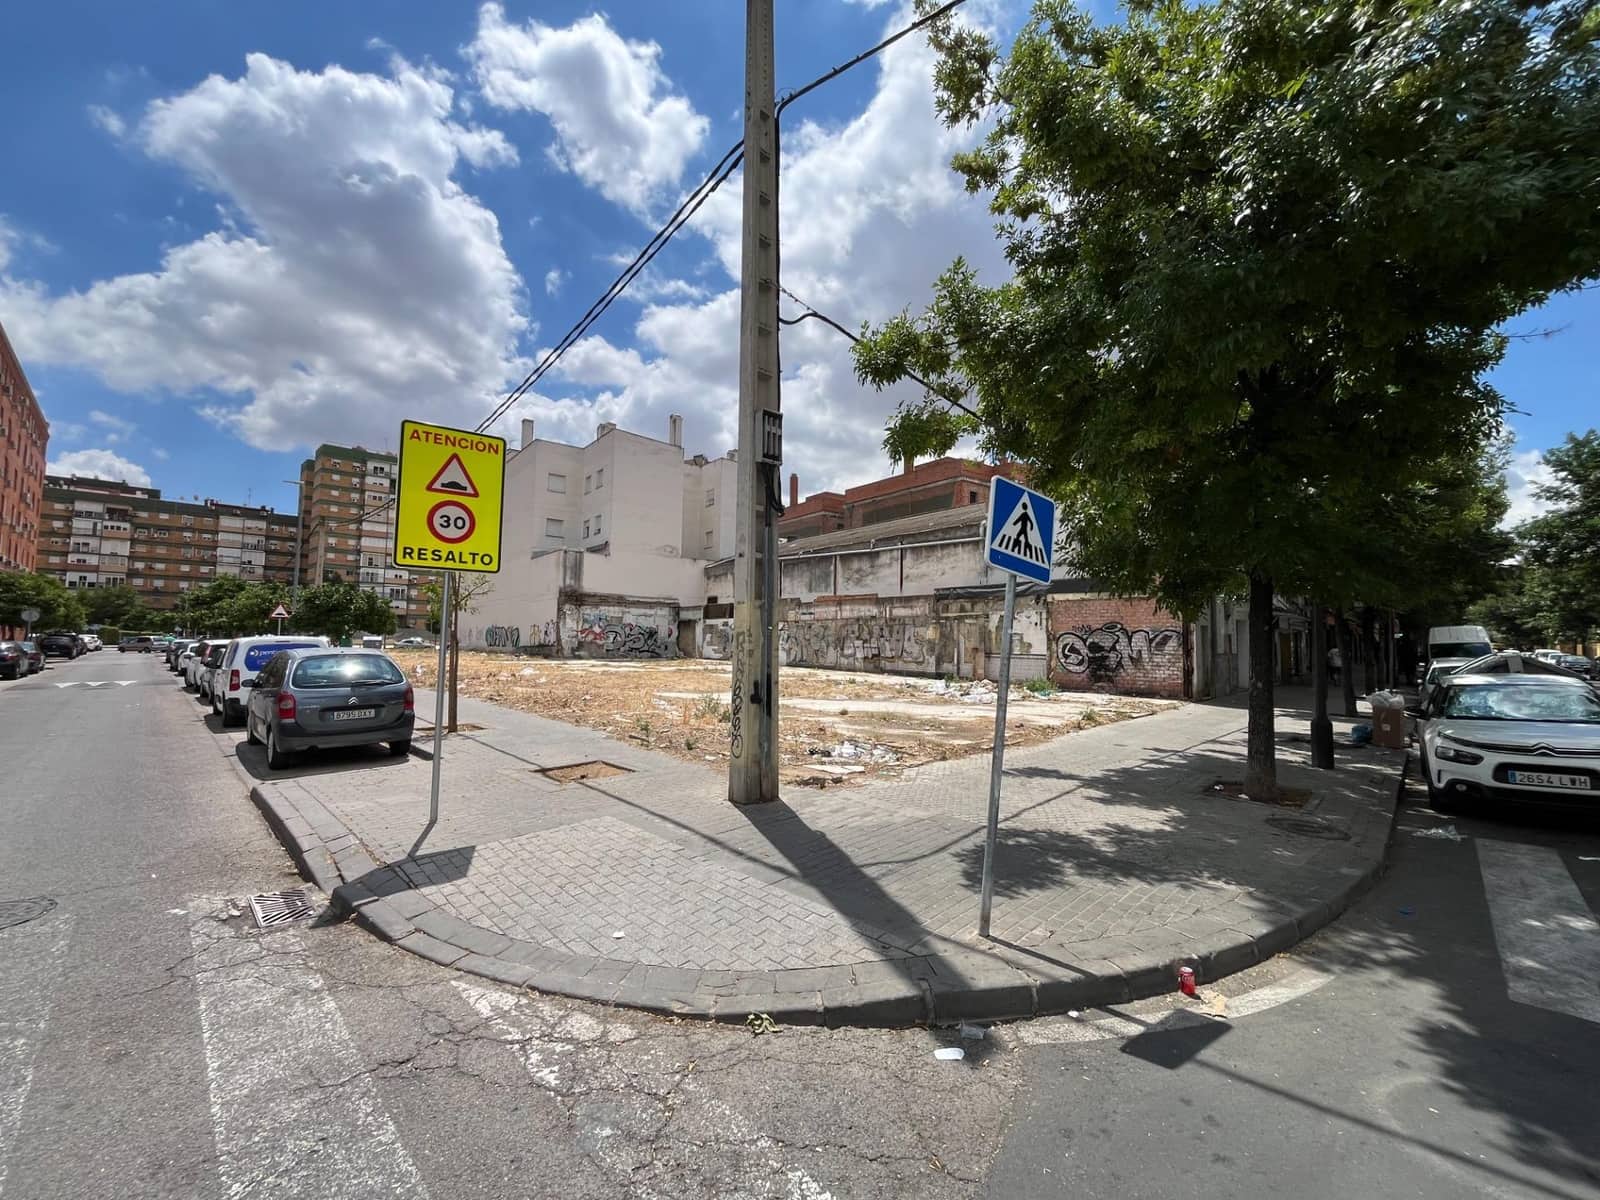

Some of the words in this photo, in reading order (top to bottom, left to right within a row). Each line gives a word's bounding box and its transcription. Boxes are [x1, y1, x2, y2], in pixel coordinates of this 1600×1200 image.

[439, 514, 466, 529] 30
[402, 546, 493, 566] RESALTO
[1518, 773, 1554, 785] 2654
